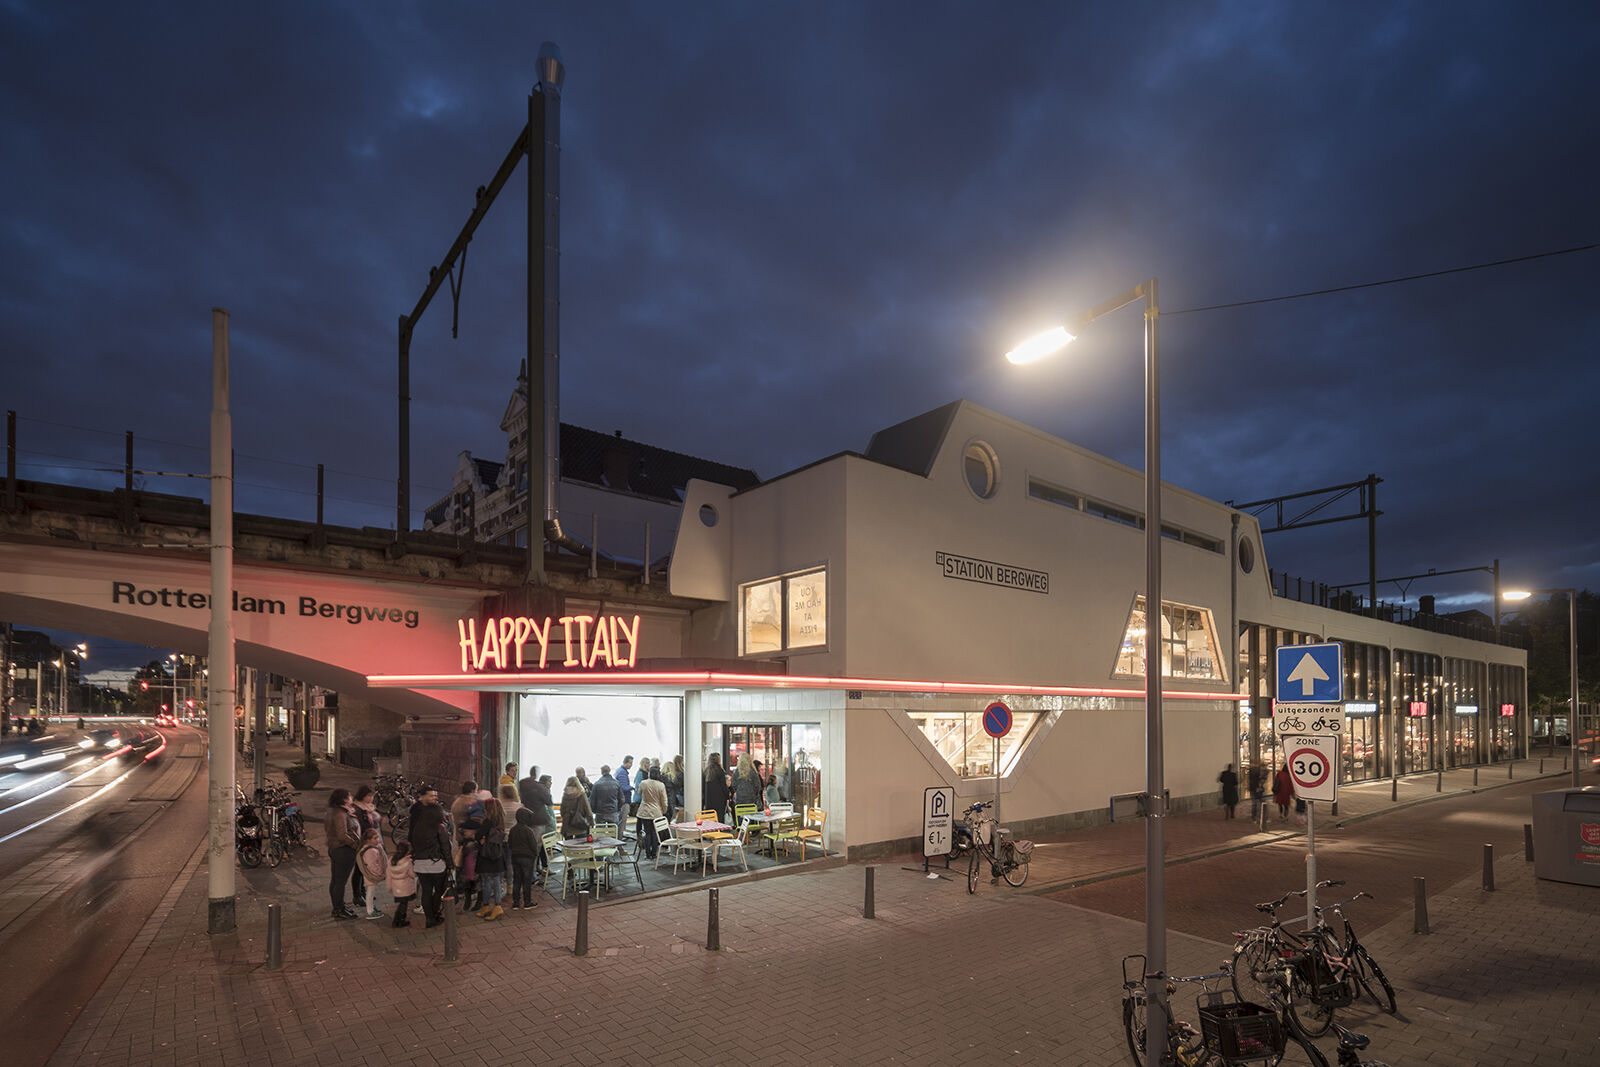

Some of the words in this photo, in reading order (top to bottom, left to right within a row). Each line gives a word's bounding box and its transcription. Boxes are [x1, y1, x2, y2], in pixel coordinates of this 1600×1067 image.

[946, 558, 992, 580] STATION
[997, 567, 1047, 590] BERGWEG
[112, 581, 285, 614] Rotteam
[299, 596, 419, 628] Bergweg
[458, 616, 552, 673] HAPPY
[559, 615, 640, 668] ITALY
[1278, 706, 1340, 714] uitgezonderd
[1294, 761, 1322, 776] 30
[935, 798, 942, 813] P
